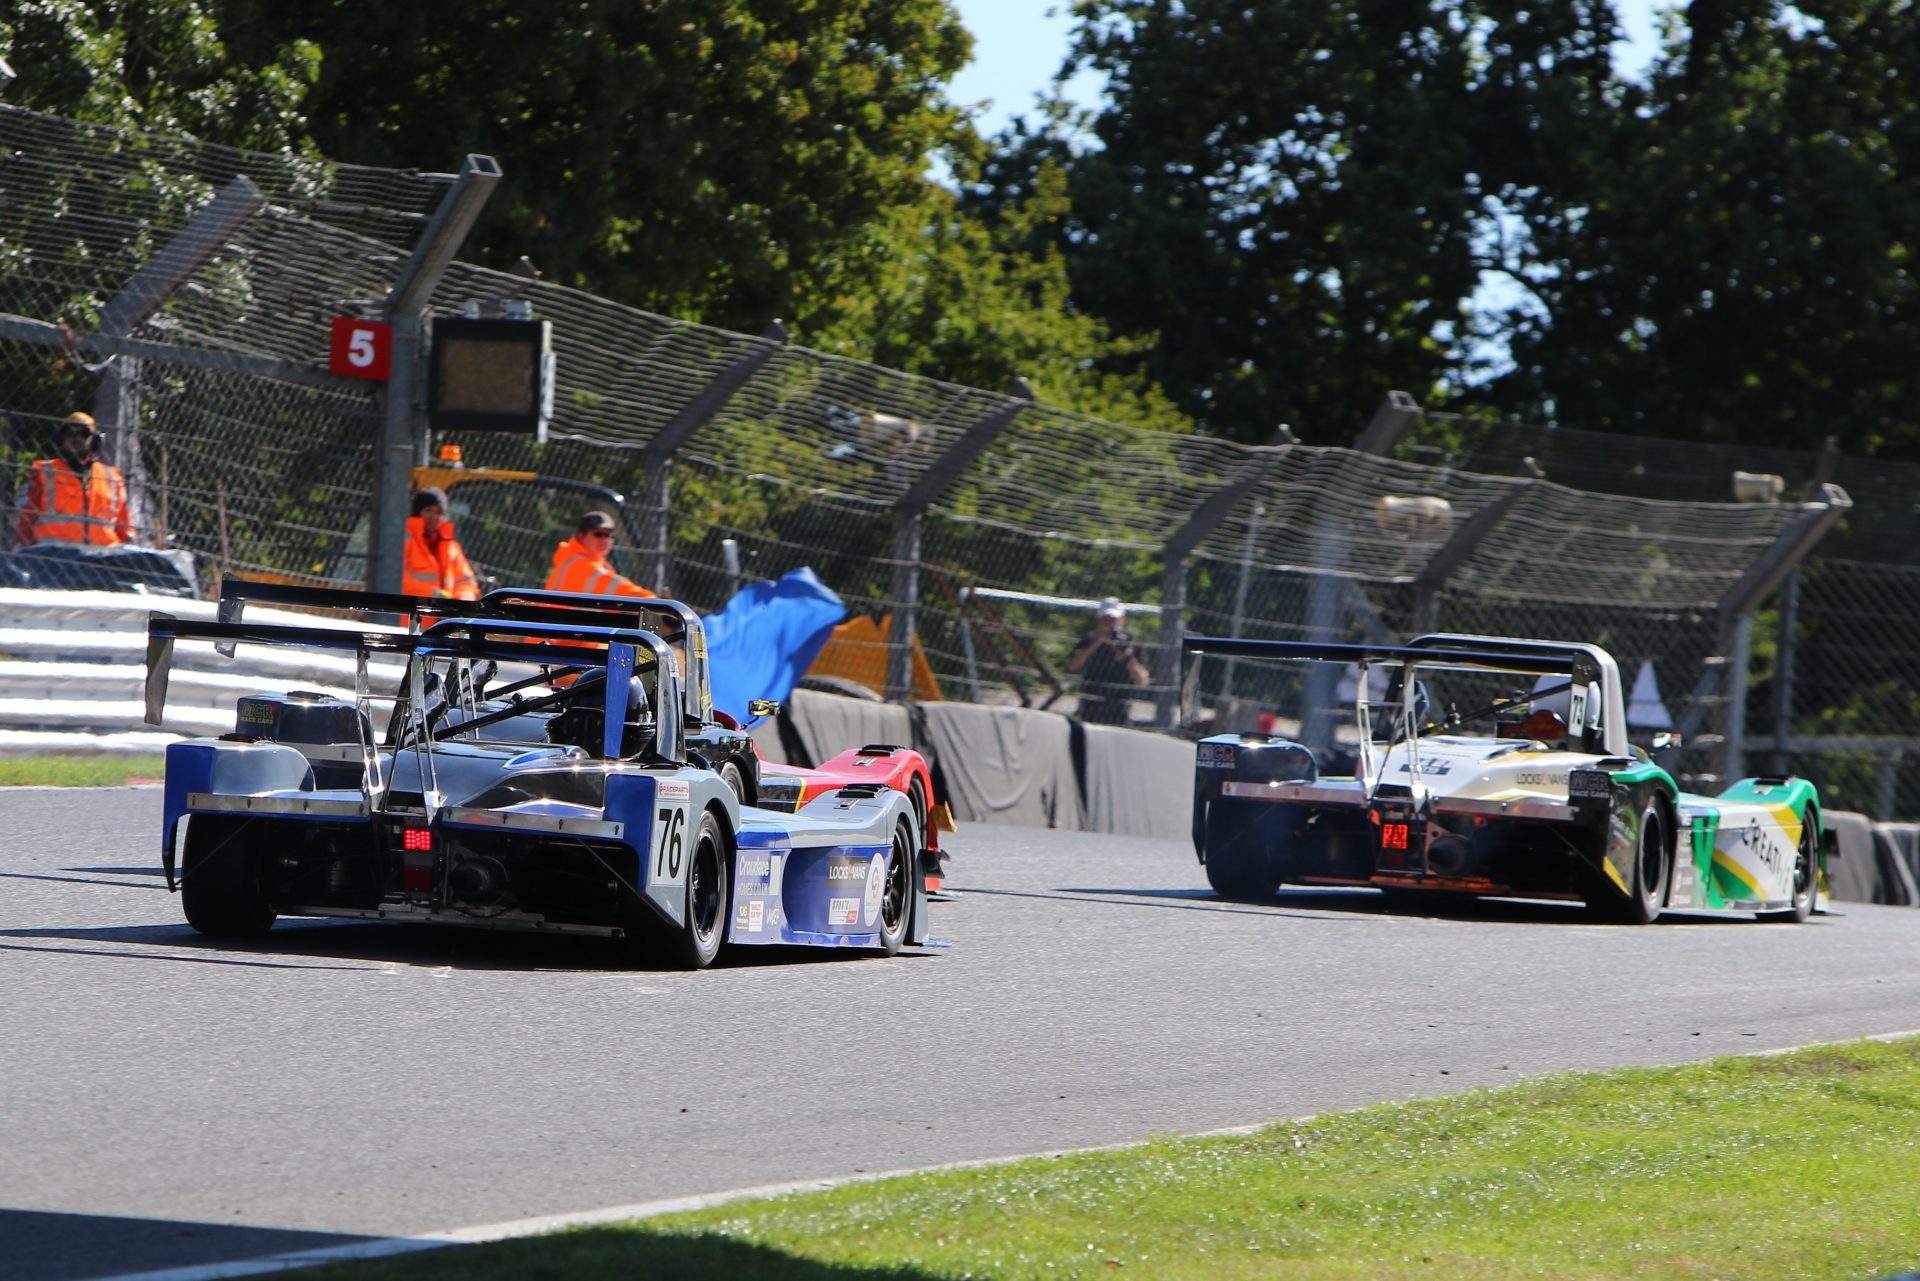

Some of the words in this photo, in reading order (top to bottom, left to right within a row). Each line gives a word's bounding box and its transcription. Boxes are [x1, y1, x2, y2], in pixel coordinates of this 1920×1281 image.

[348, 329, 374, 367] 5
[243, 703, 273, 718] MCR
[1216, 761, 1235, 769] CARS
[1571, 772, 1609, 791] MCR
[658, 807, 684, 879] 76
